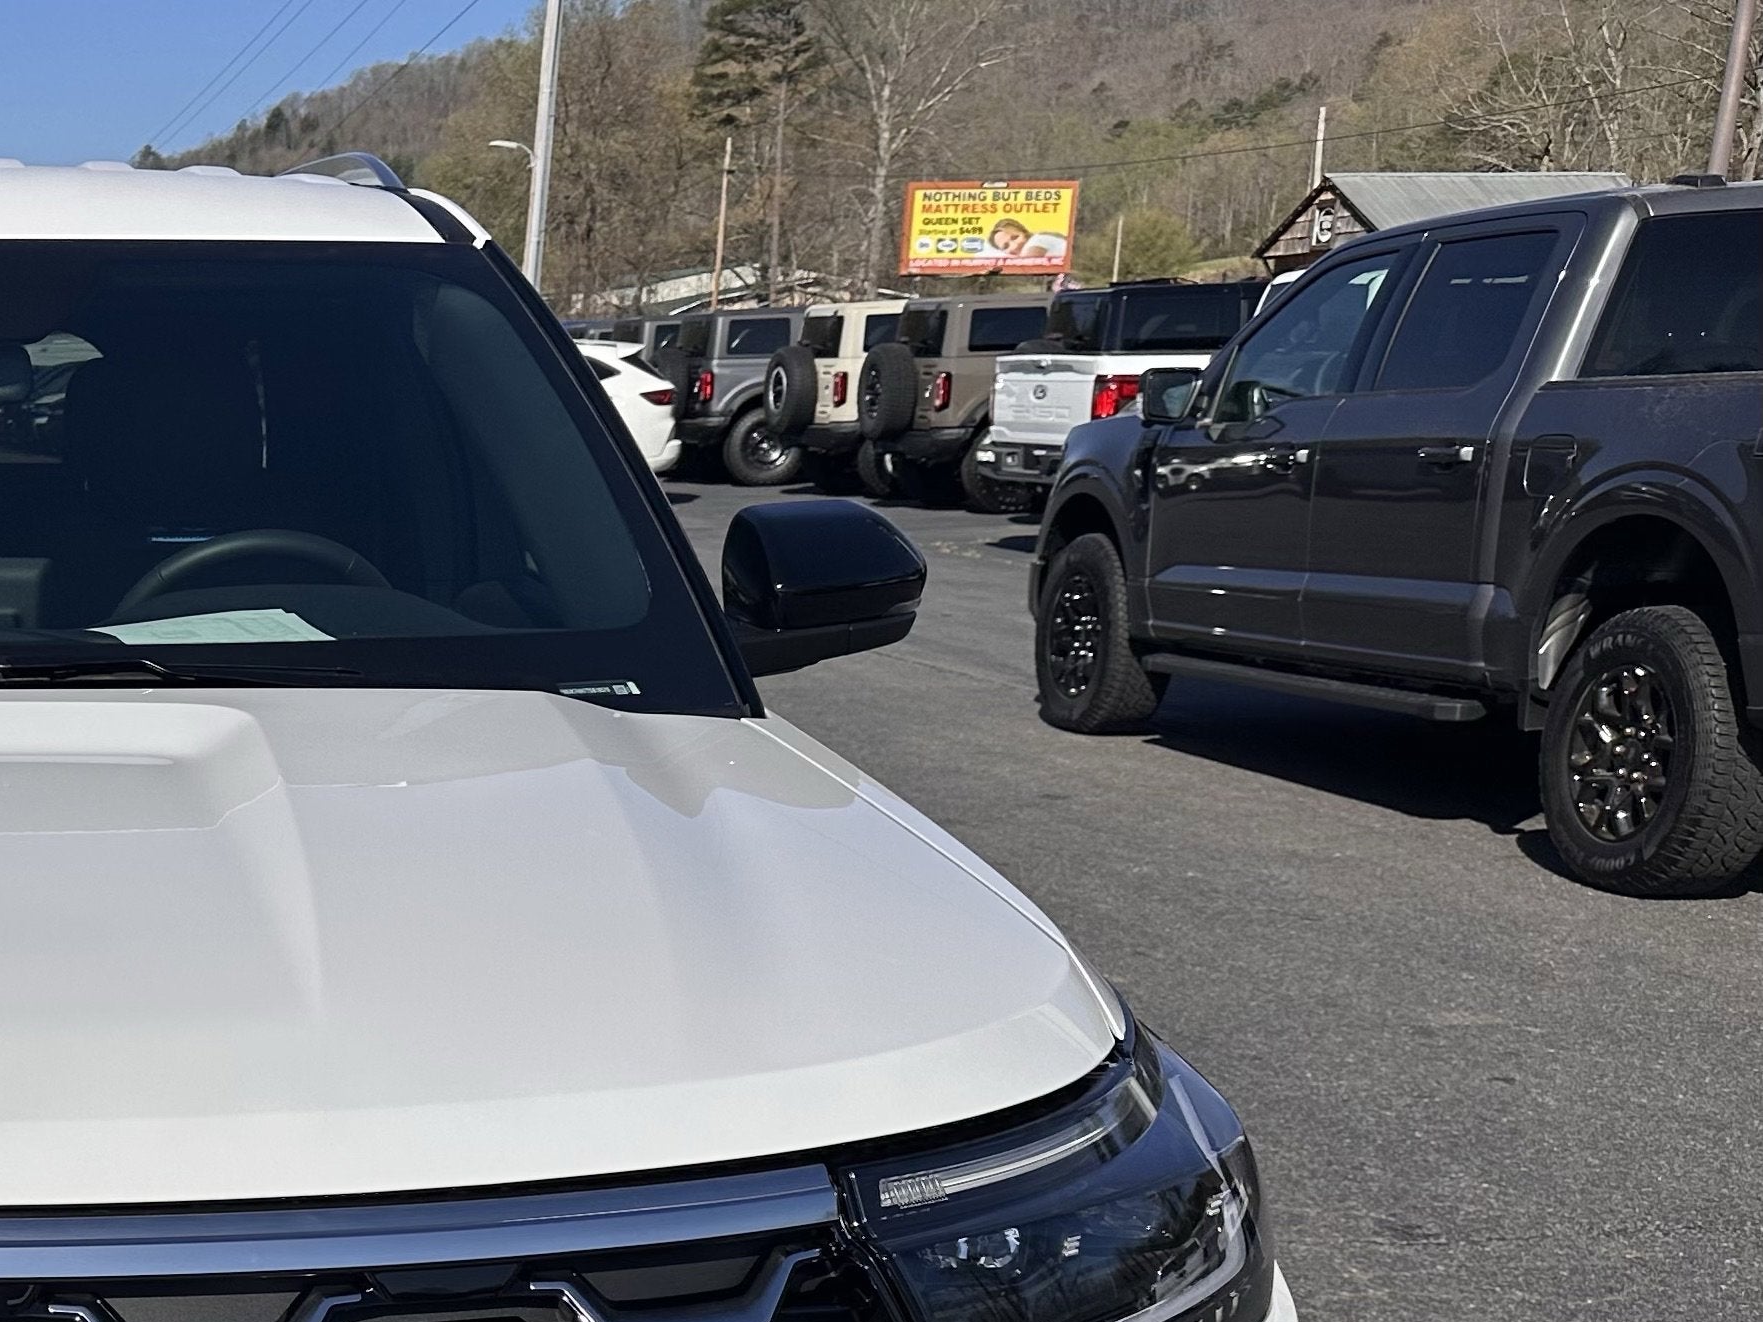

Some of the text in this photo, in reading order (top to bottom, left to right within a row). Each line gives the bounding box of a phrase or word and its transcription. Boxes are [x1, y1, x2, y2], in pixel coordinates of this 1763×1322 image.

[922, 191, 1062, 202] NOTHING BUT BEDS
[922, 202, 1060, 214] MATTRESS OUTLET
[922, 217, 981, 226] QUEEN SET
